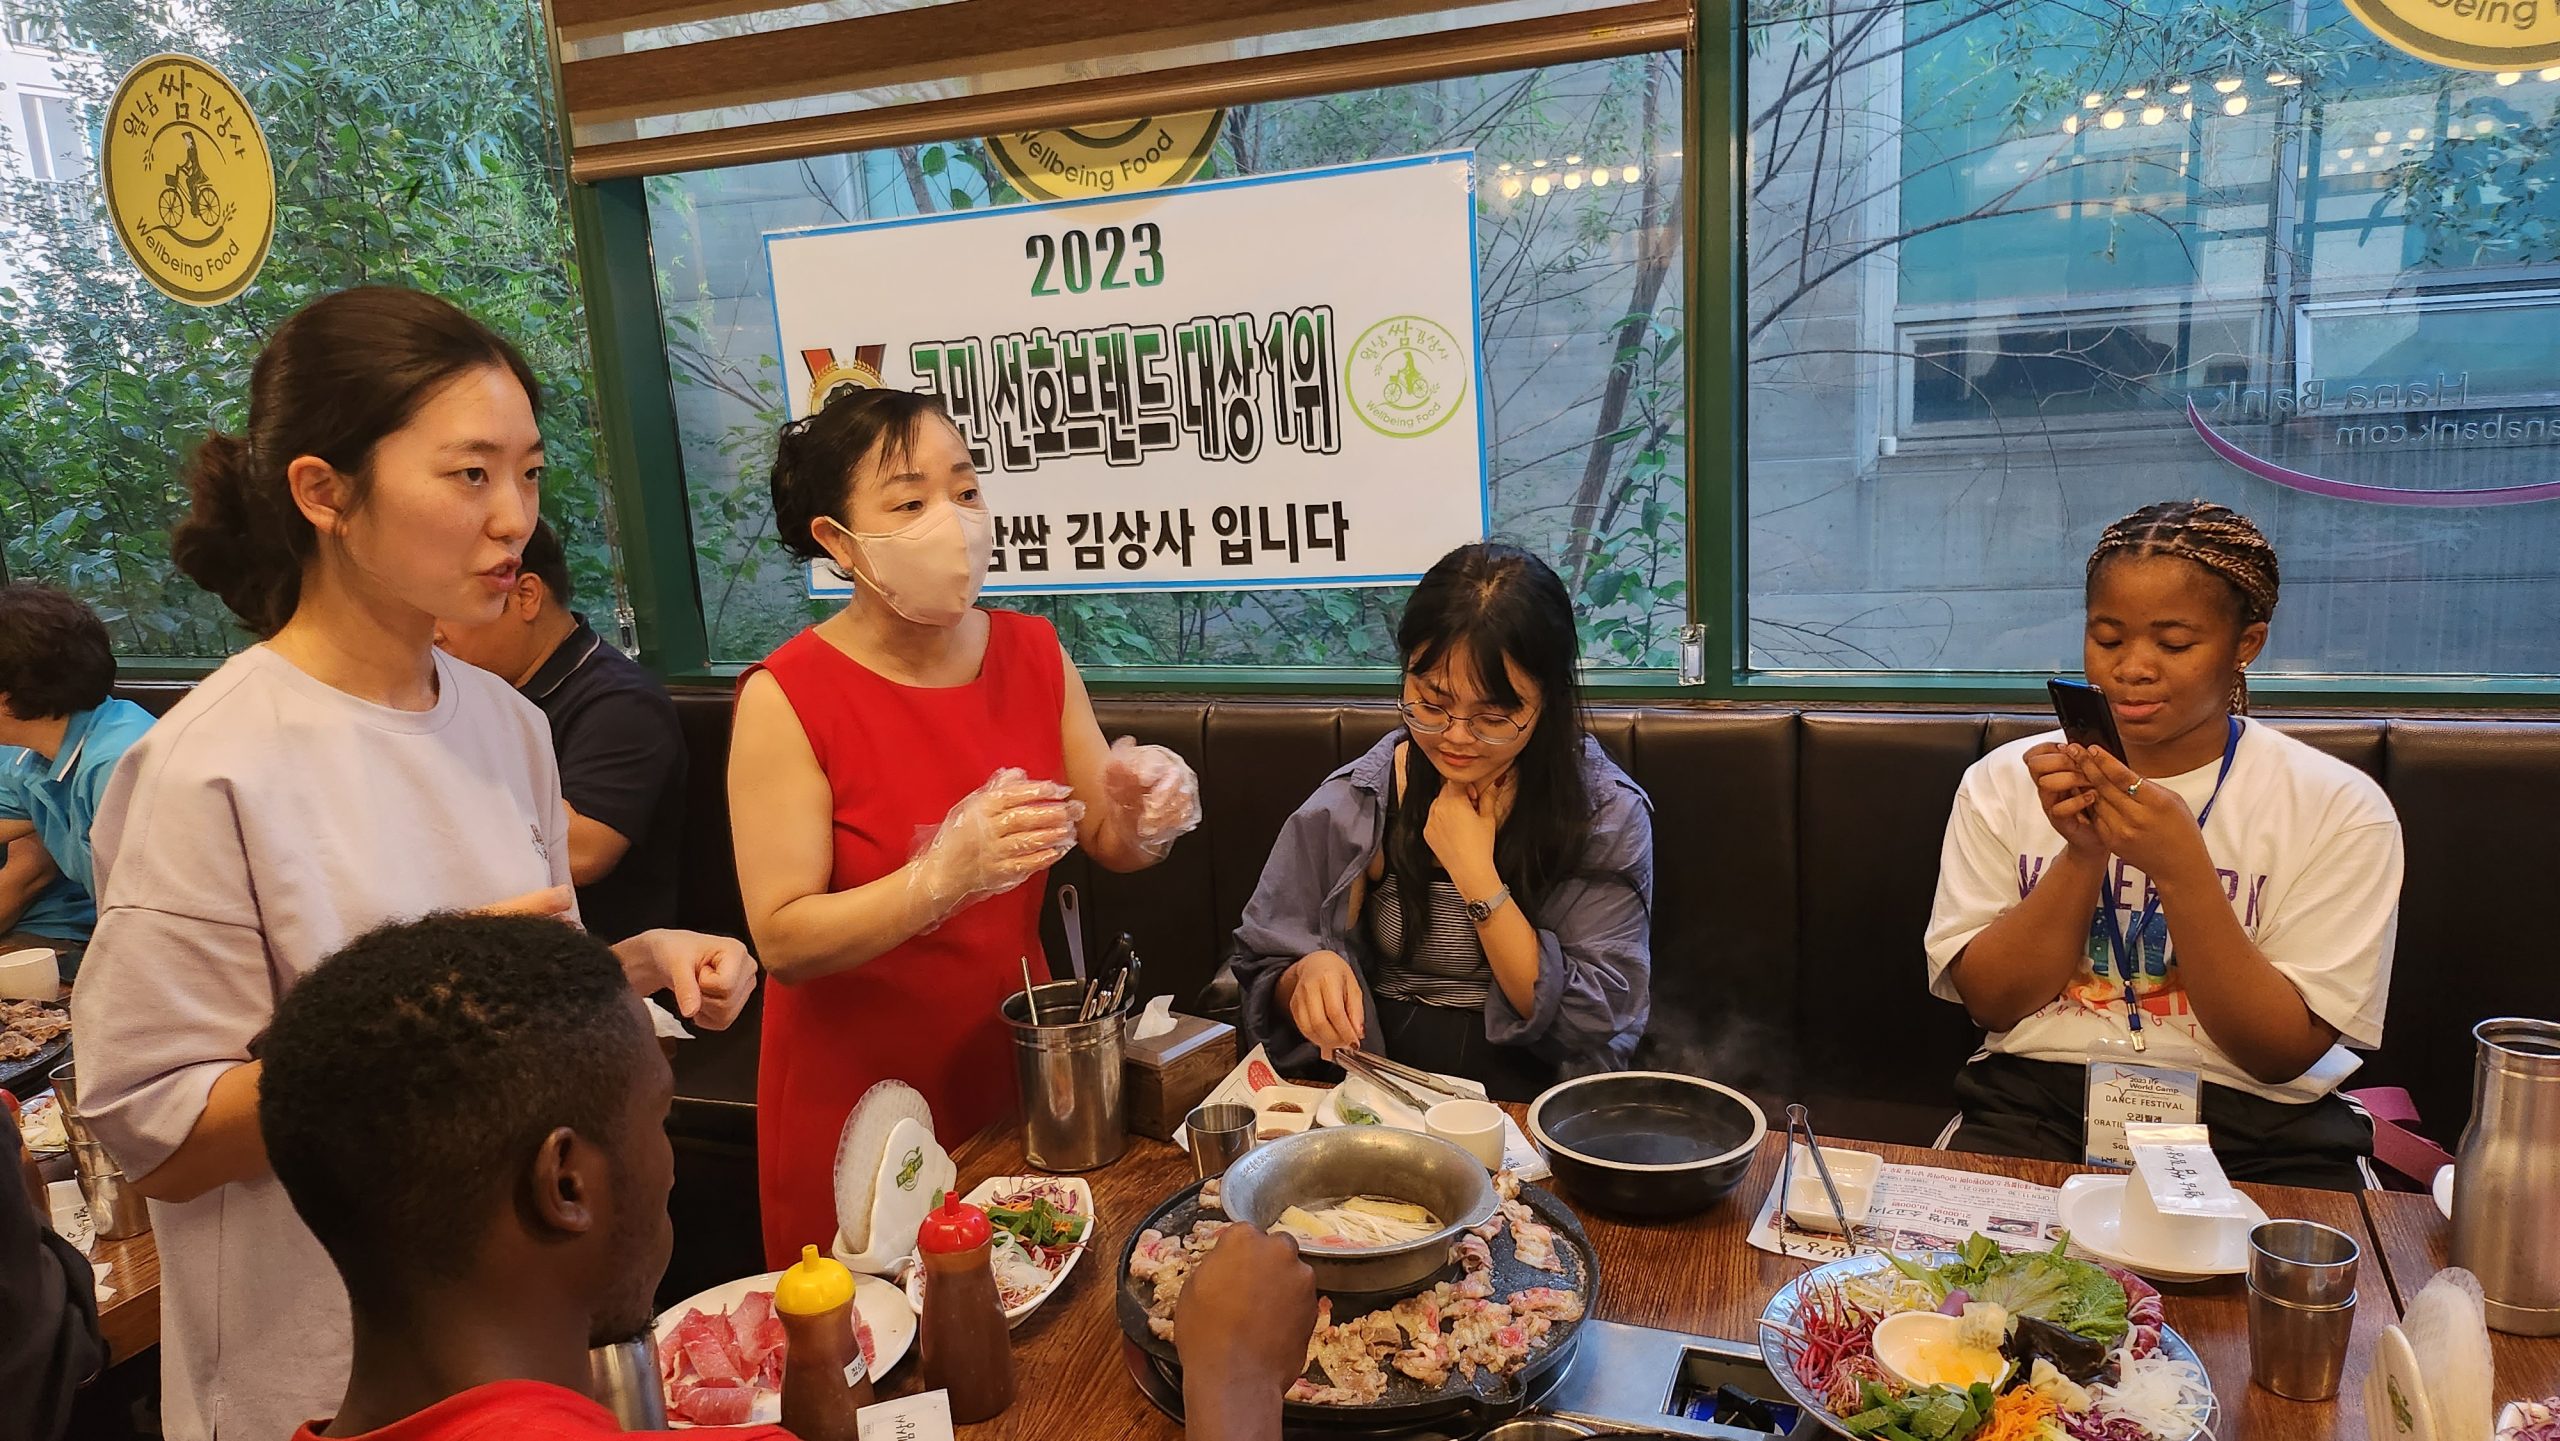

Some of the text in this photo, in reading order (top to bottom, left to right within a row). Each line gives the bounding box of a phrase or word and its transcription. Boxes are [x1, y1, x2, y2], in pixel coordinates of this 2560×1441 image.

[2428, 0, 2538, 30] eing
[1014, 128, 1175, 192] Wellbeing Food
[136, 216, 240, 282] Wellbeing Food
[1025, 221, 1165, 298] 2023
[1366, 400, 1441, 428] Wellbeing Food
[1066, 508, 1195, 571] 김상사
[1211, 501, 1350, 566] 입니다
[2106, 1095, 2137, 1106] DANCE
[2140, 1099, 2185, 1111] FESTIVAL
[2155, 1086, 2180, 1094] Camp
[2112, 1142, 2131, 1151] Sou
